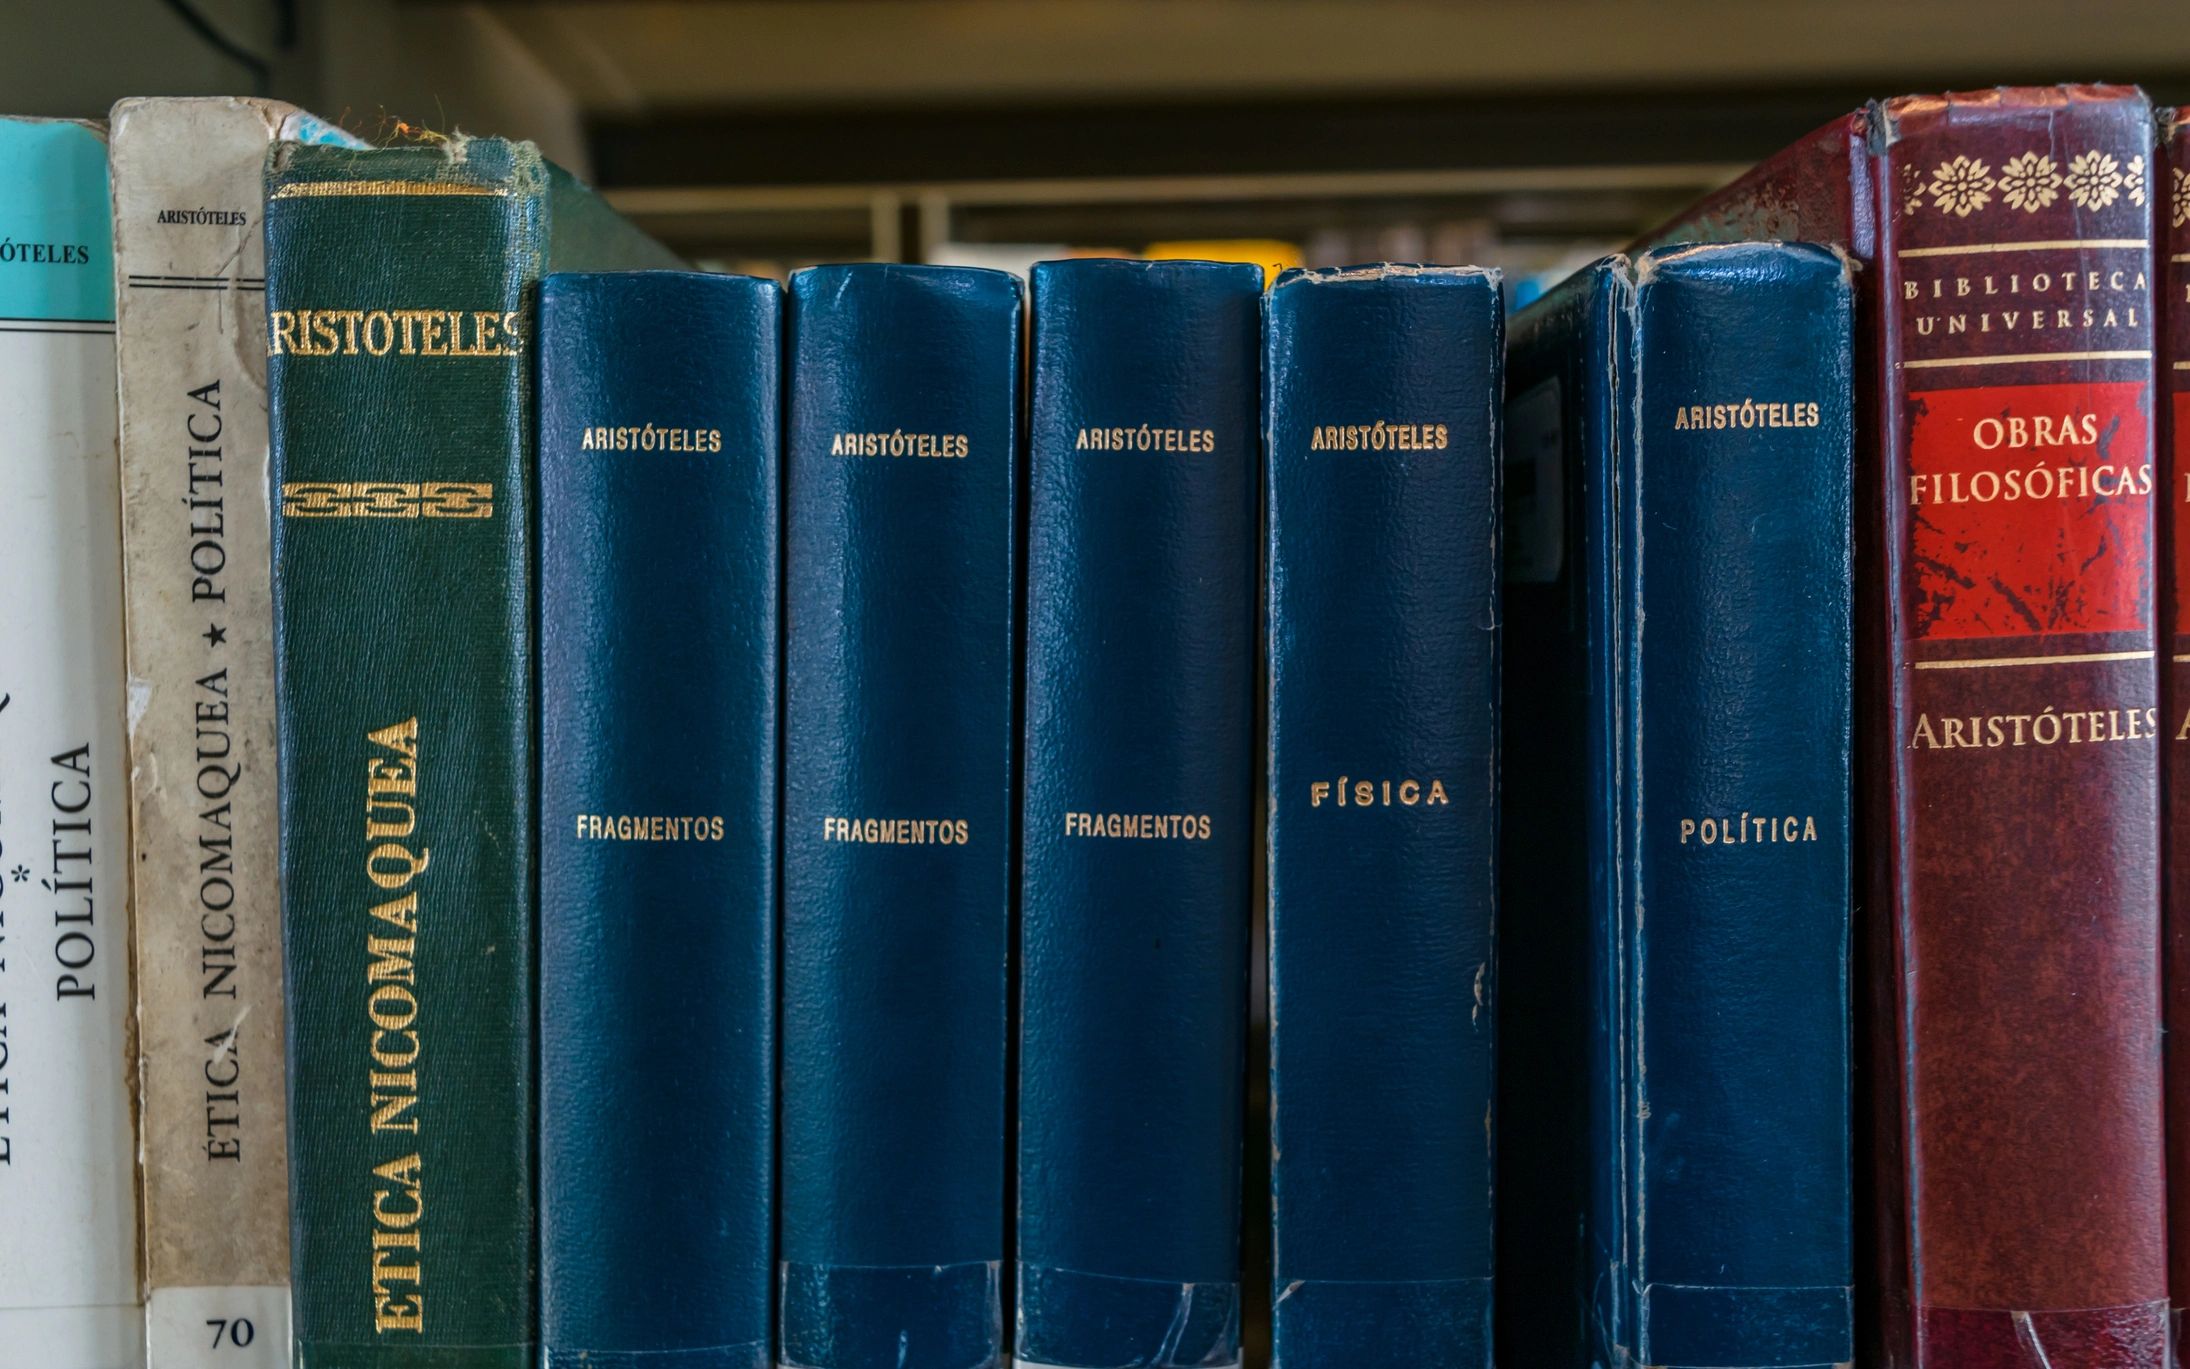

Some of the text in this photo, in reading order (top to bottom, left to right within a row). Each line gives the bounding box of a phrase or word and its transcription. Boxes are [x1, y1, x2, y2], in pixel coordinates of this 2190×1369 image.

[157, 206, 247, 225] ARISTÓTELES
[1904, 271, 2148, 300] BIBLIOTECA
[267, 309, 524, 357] RISTOTELES
[1916, 307, 2139, 336] UNIVERSAL
[1674, 398, 1820, 430] ARISTÓTELES
[581, 423, 723, 453] ARISTÓTELES
[831, 429, 969, 459] ARISTÓTELES
[1075, 424, 1216, 453] ARISTÓTELES
[1311, 420, 1449, 450] ARISTÓTELES
[1973, 413, 2098, 450] OBRAS
[1910, 461, 2153, 506] FILOSÓFICAS
[181, 379, 242, 1163] ÉTICA NICOMAQUEA POLÍTICA
[1311, 777, 1449, 807] FÍSICA
[576, 815, 725, 842] FRAGMENTOS
[824, 818, 969, 845] FRAGMENTOS
[1064, 812, 1212, 840] FRAGMENTOS
[1681, 812, 1818, 844] POLÍTICA
[42, 742, 96, 1002] POLÍTICA
[366, 716, 430, 1335] ETICA NICOMAQUEA
[206, 1317, 255, 1350] 70
